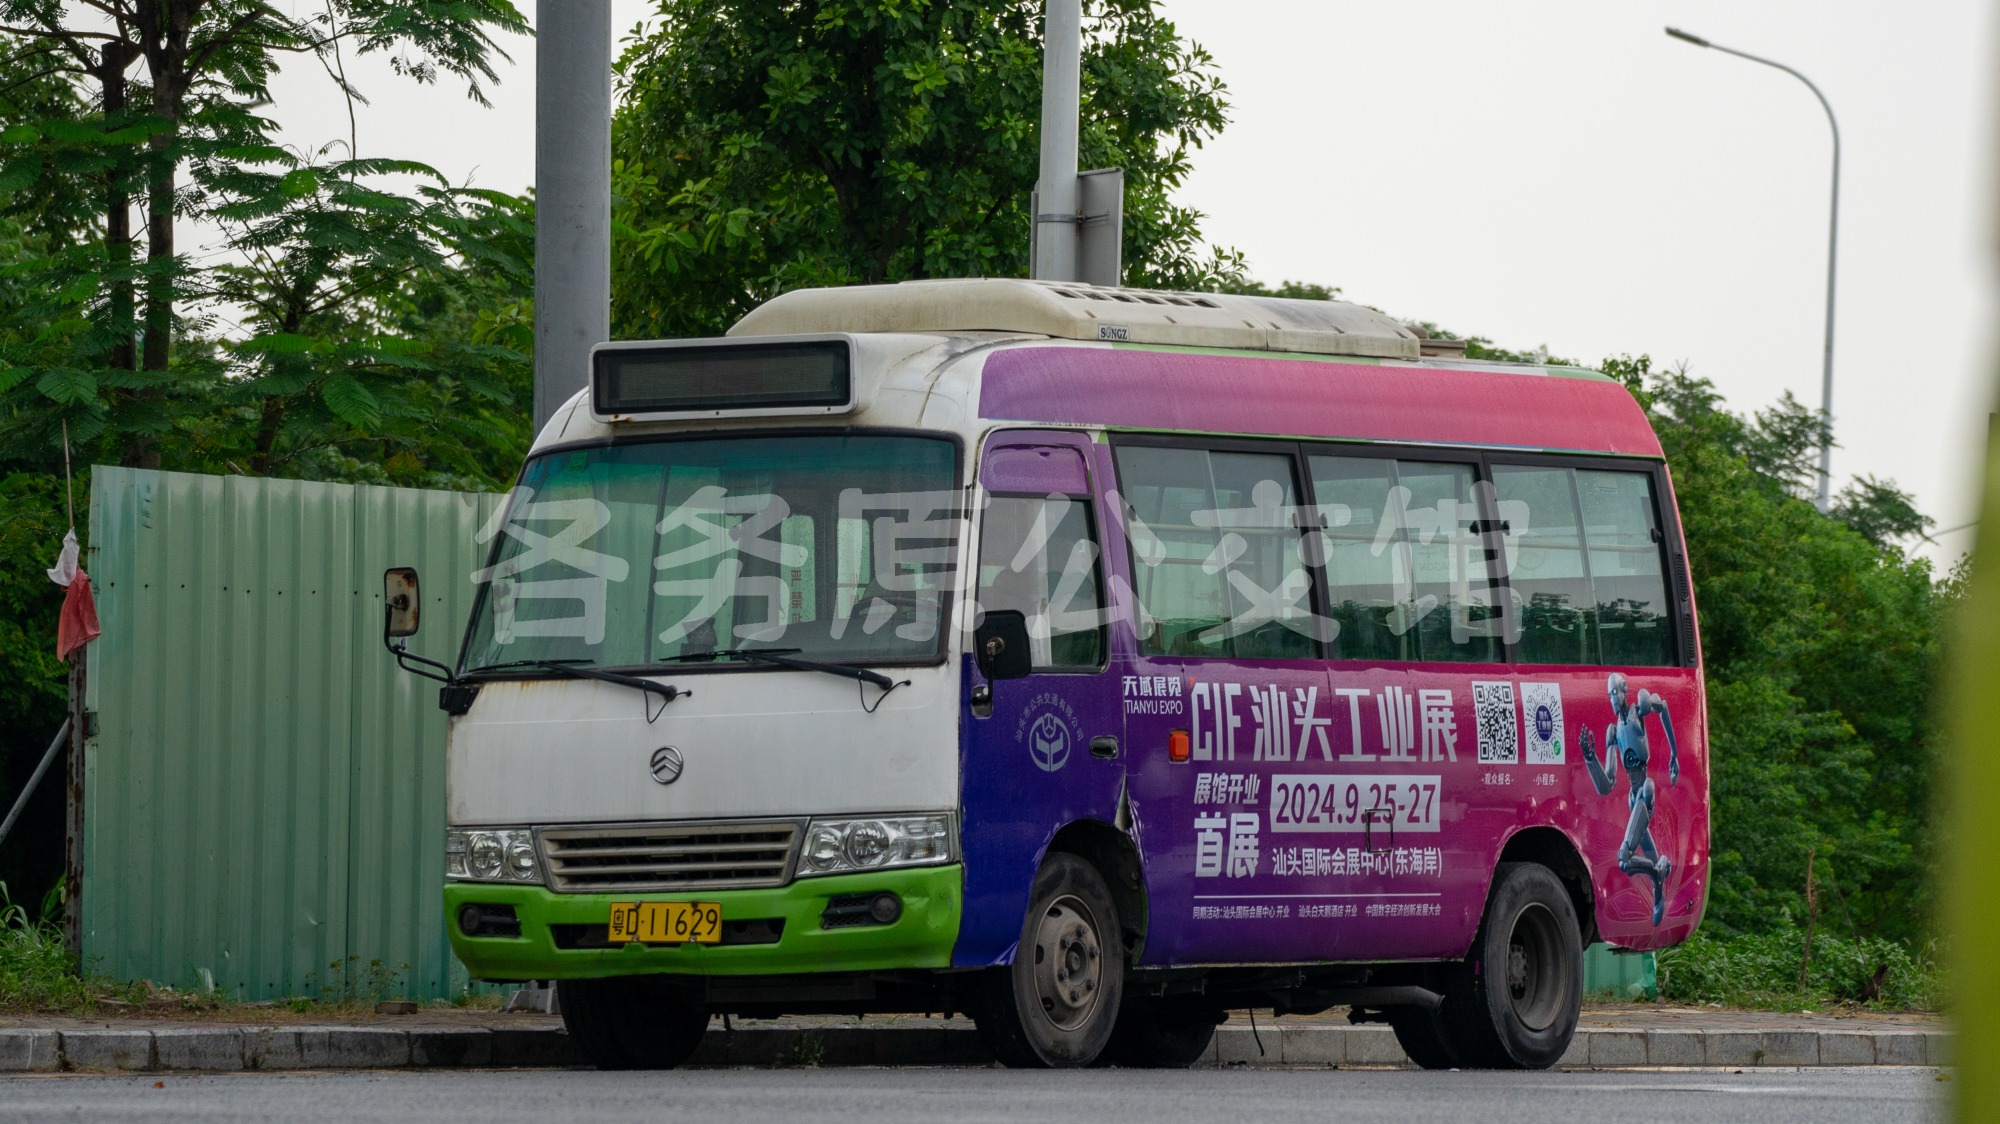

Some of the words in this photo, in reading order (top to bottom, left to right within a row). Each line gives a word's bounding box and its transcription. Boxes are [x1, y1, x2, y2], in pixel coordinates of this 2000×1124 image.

[1100, 326, 1128, 340] SONGZ
[1123, 676, 1182, 697] 天域展览
[1124, 700, 1158, 715] TIANYU
[1160, 700, 1183, 715] EXPO
[1249, 684, 1458, 763] 汕头工业展
[1193, 772, 1261, 805] 展馆开业
[1275, 783, 1437, 824] 2024.9.25-27
[1193, 811, 1260, 879] 首展
[1365, 903, 1442, 917] 中国数字经济创新发展大会
